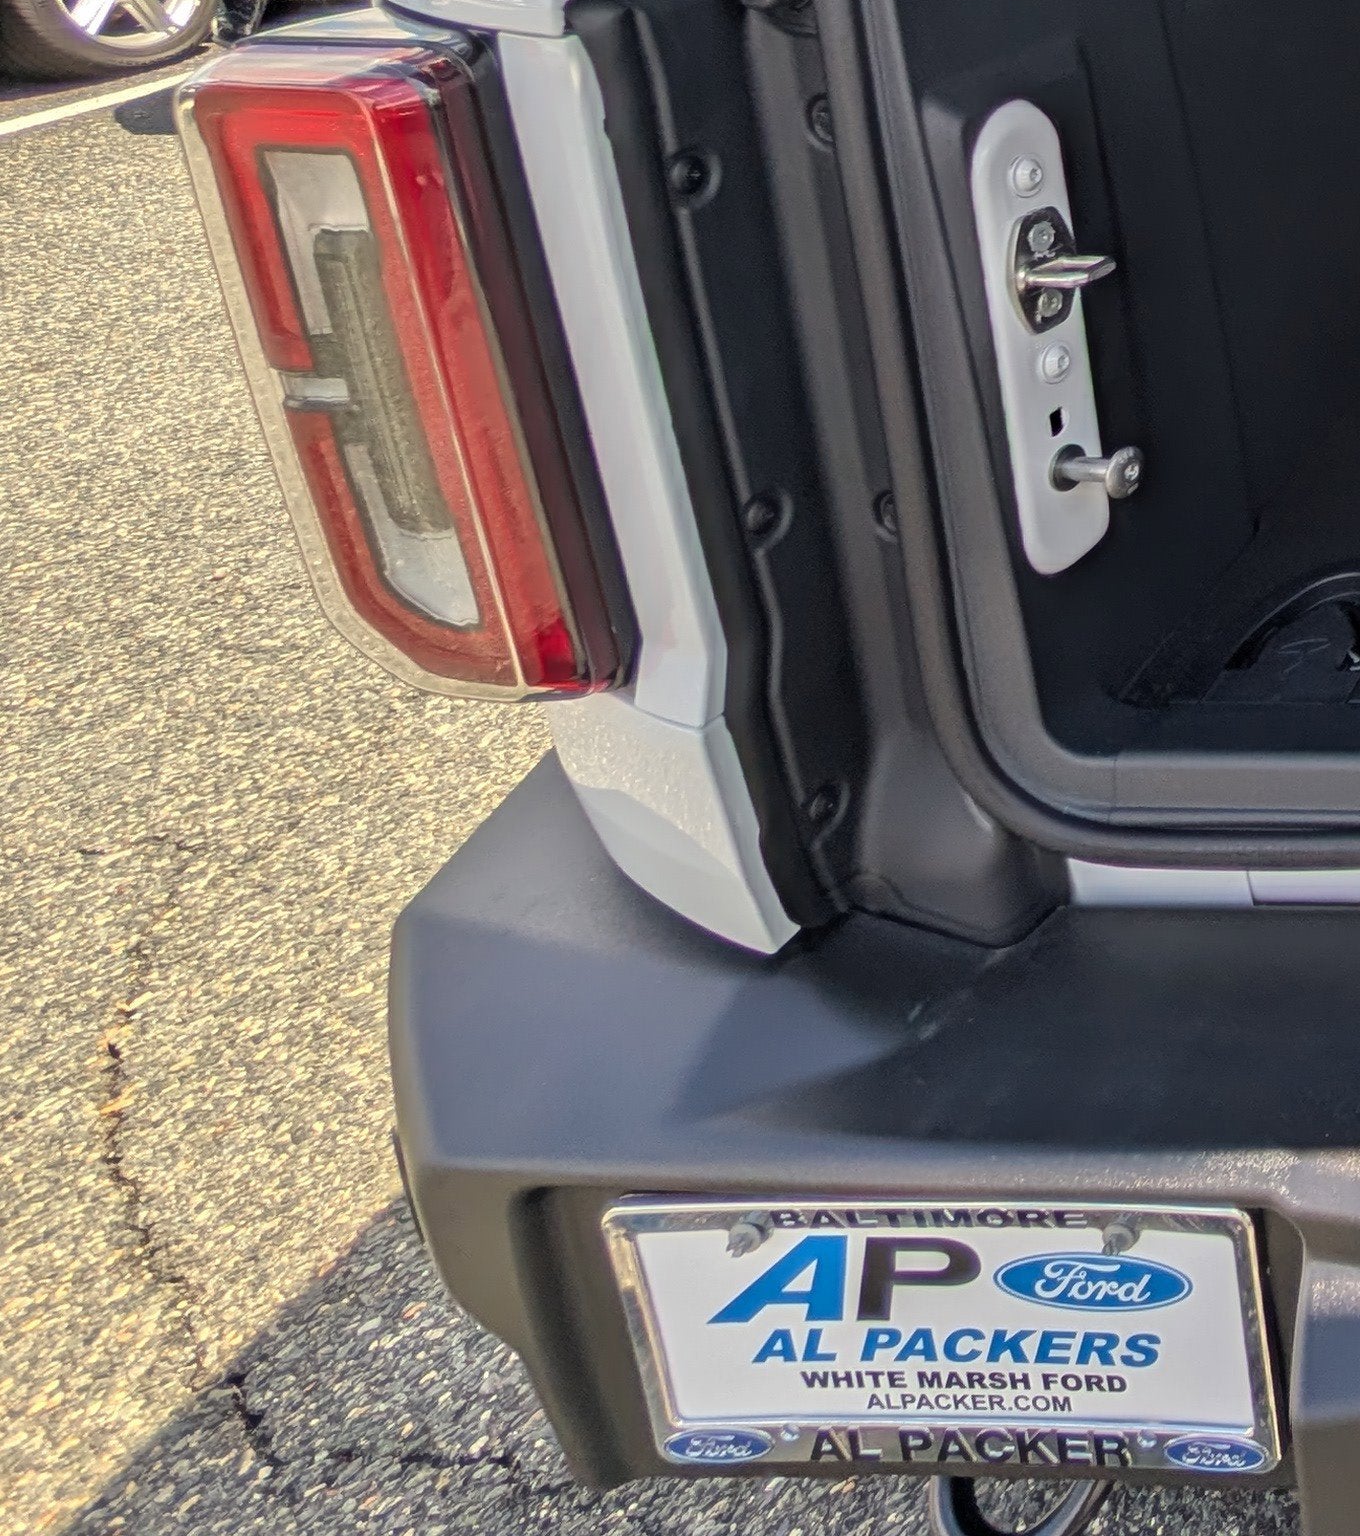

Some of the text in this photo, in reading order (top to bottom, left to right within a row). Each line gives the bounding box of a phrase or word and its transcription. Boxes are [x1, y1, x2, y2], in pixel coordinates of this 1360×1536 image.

[770, 1208, 1088, 1228] BALTIMORE
[706, 1234, 981, 1325] AP
[1034, 1259, 1152, 1302] Ford
[751, 1327, 1162, 1366] AL PACKERS
[800, 1370, 1129, 1393] WHITE MARSH FORD
[867, 1393, 1073, 1413] ALPACKER.COM
[809, 1424, 1134, 1467] AL PACKER
